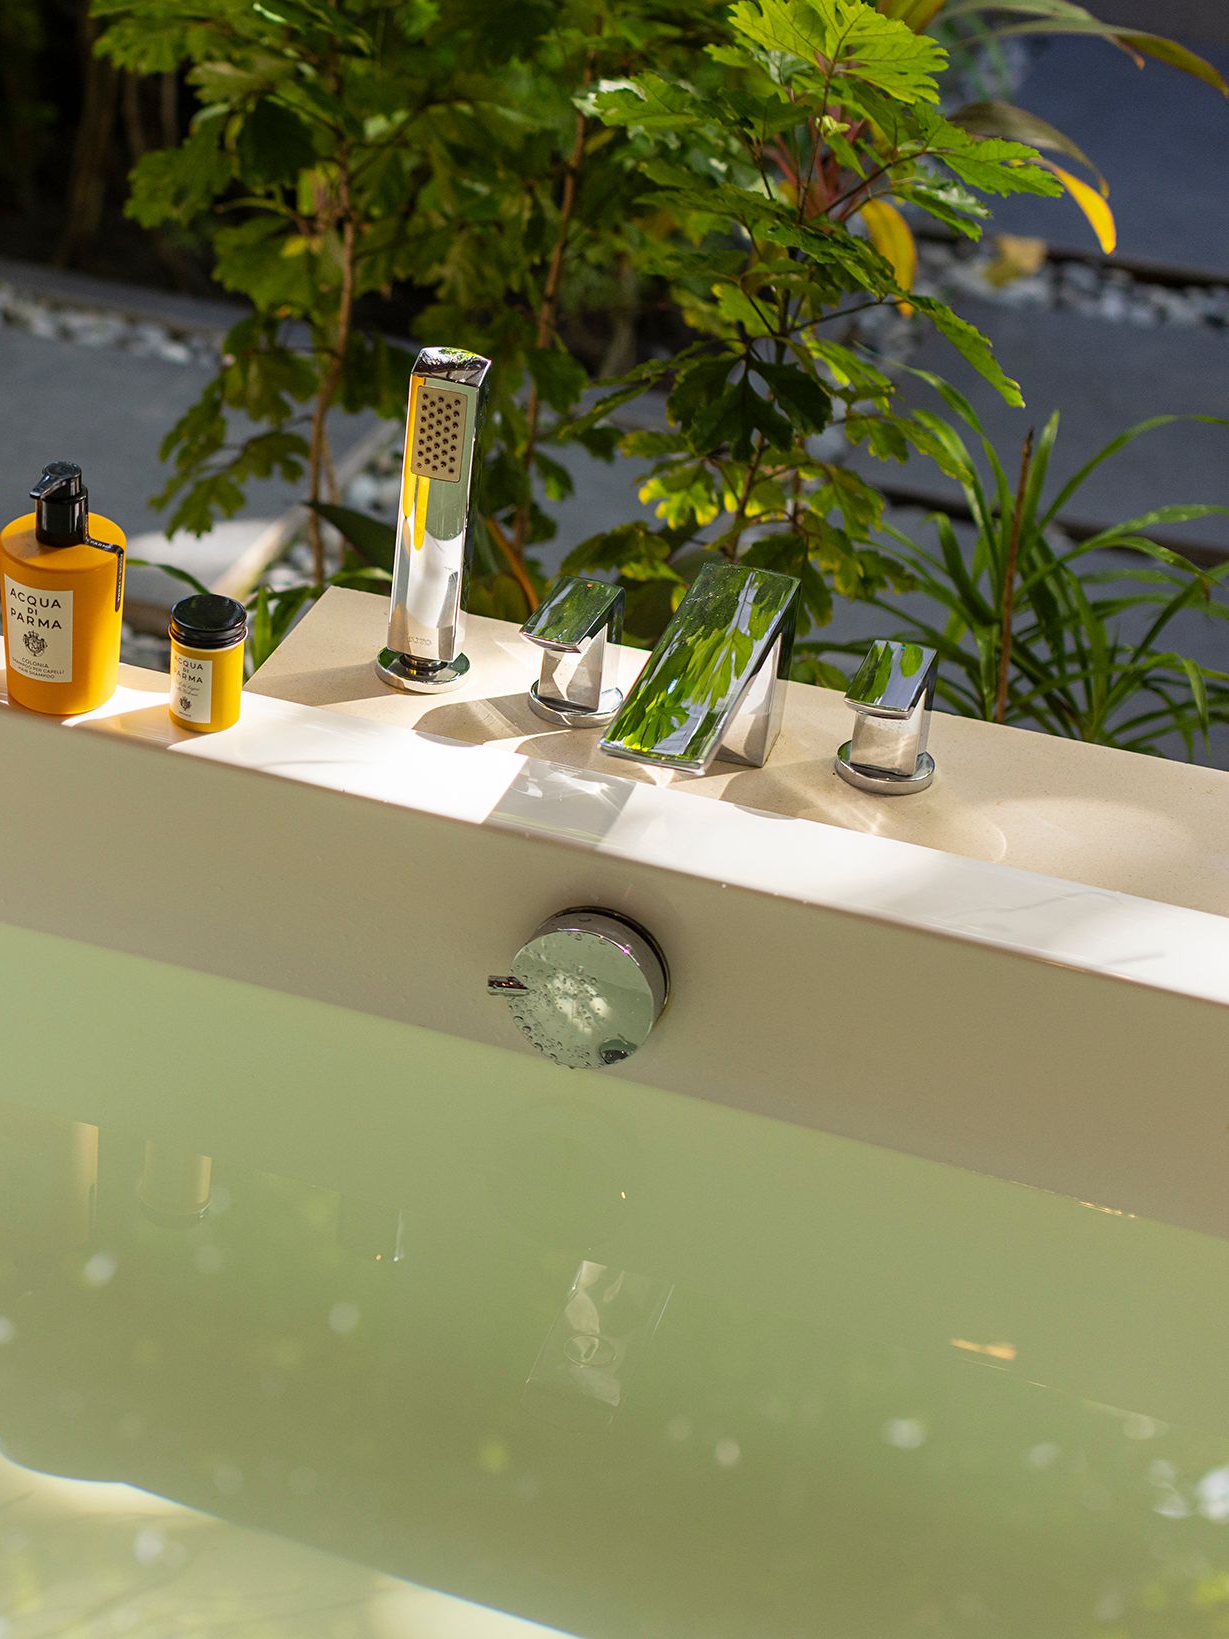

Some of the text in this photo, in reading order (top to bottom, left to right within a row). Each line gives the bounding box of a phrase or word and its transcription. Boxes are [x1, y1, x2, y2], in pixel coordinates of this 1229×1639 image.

[10, 588, 62, 609] ACQUA
[10, 607, 62, 630] PARMA
[27, 607, 38, 615] DI
[21, 657, 49, 669] COLONIA
[173, 655, 204, 670] ACQUA
[173, 667, 203, 684] PARMA
